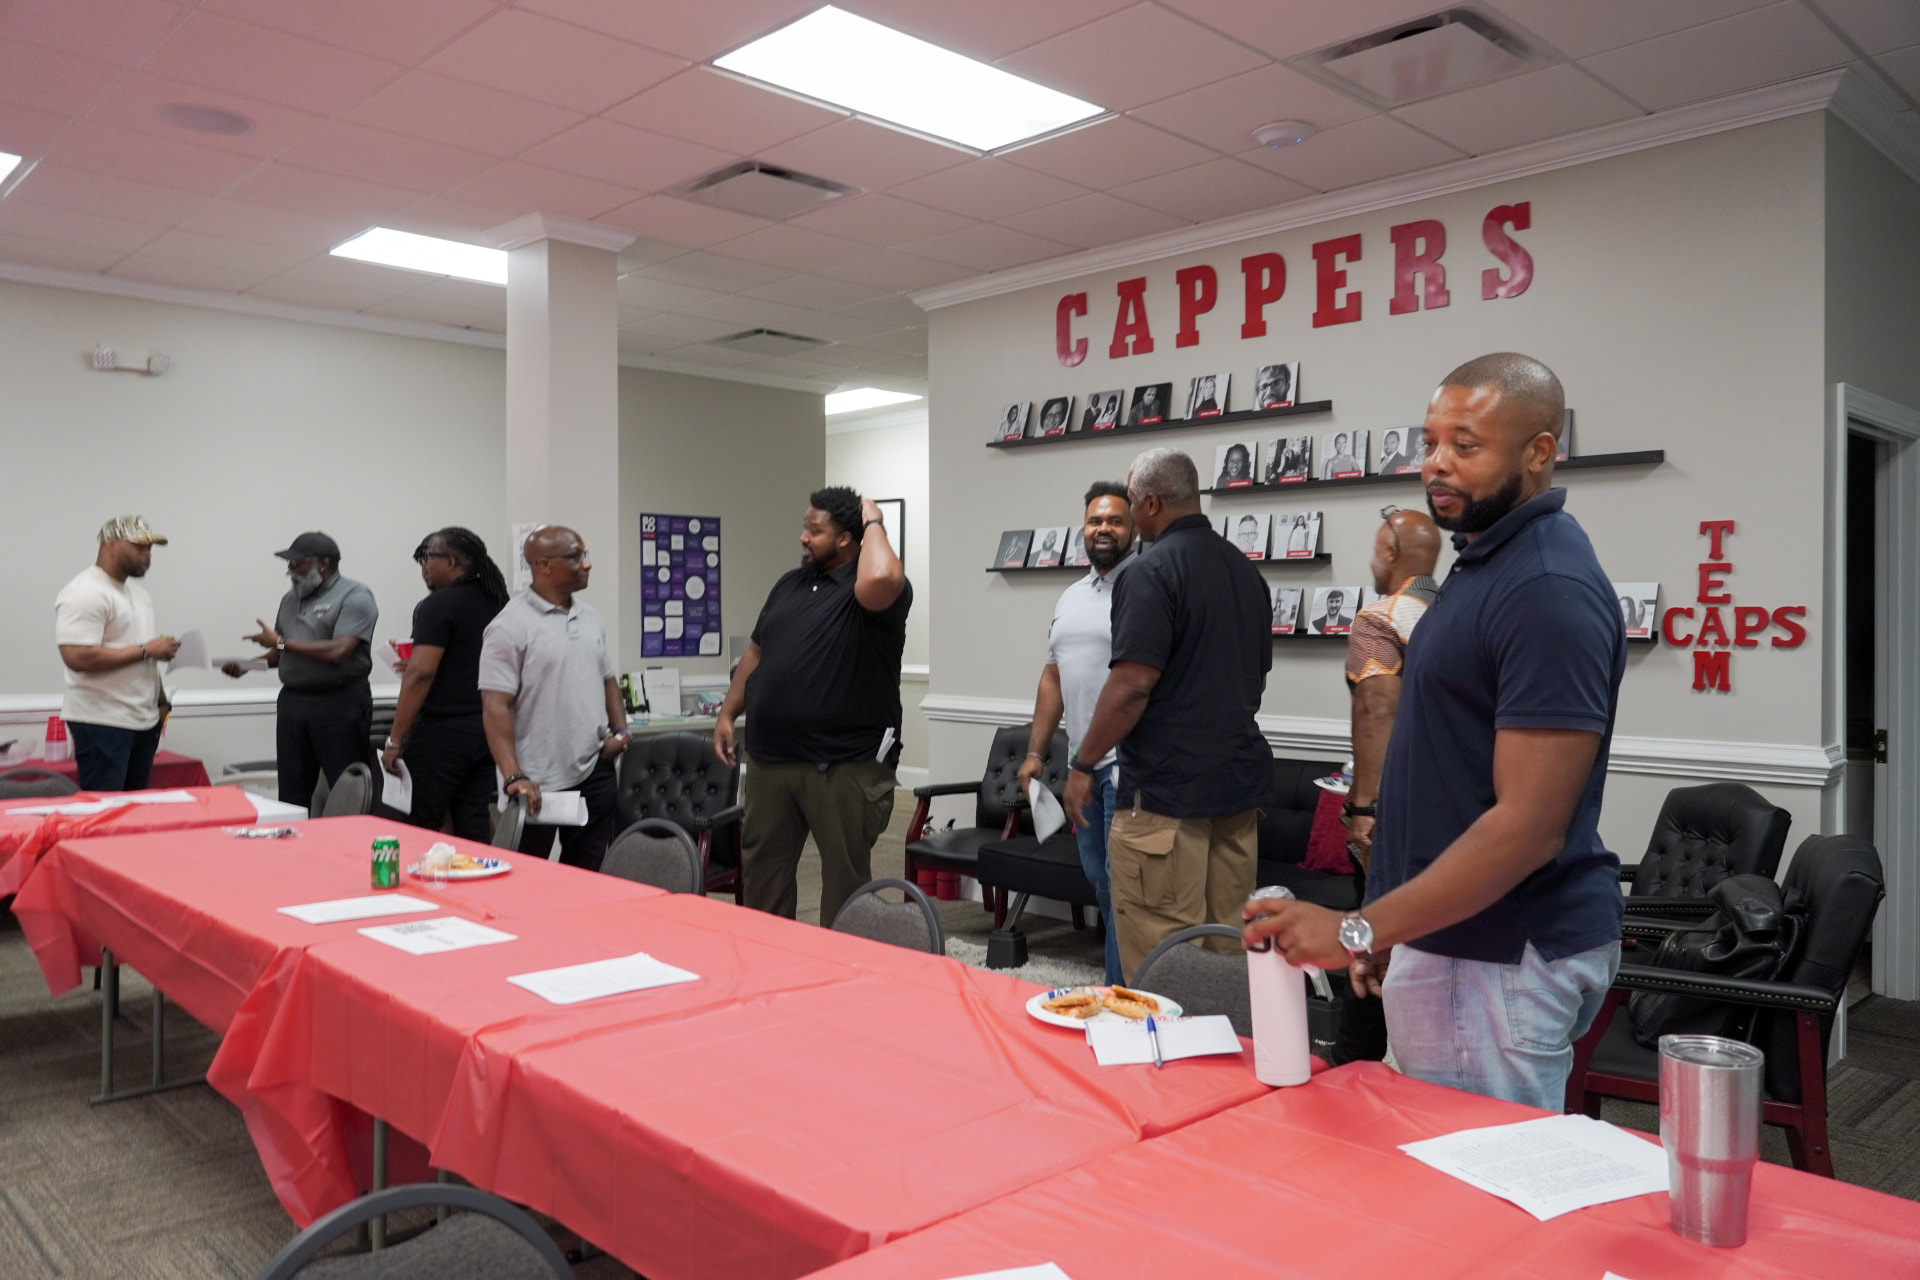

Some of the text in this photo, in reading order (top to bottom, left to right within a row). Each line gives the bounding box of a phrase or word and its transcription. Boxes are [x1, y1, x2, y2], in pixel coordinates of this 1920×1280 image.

[1056, 202, 1534, 367] CAPPERS
[1663, 606, 1806, 647] CAPS
[1692, 520, 1735, 691] TEAM
